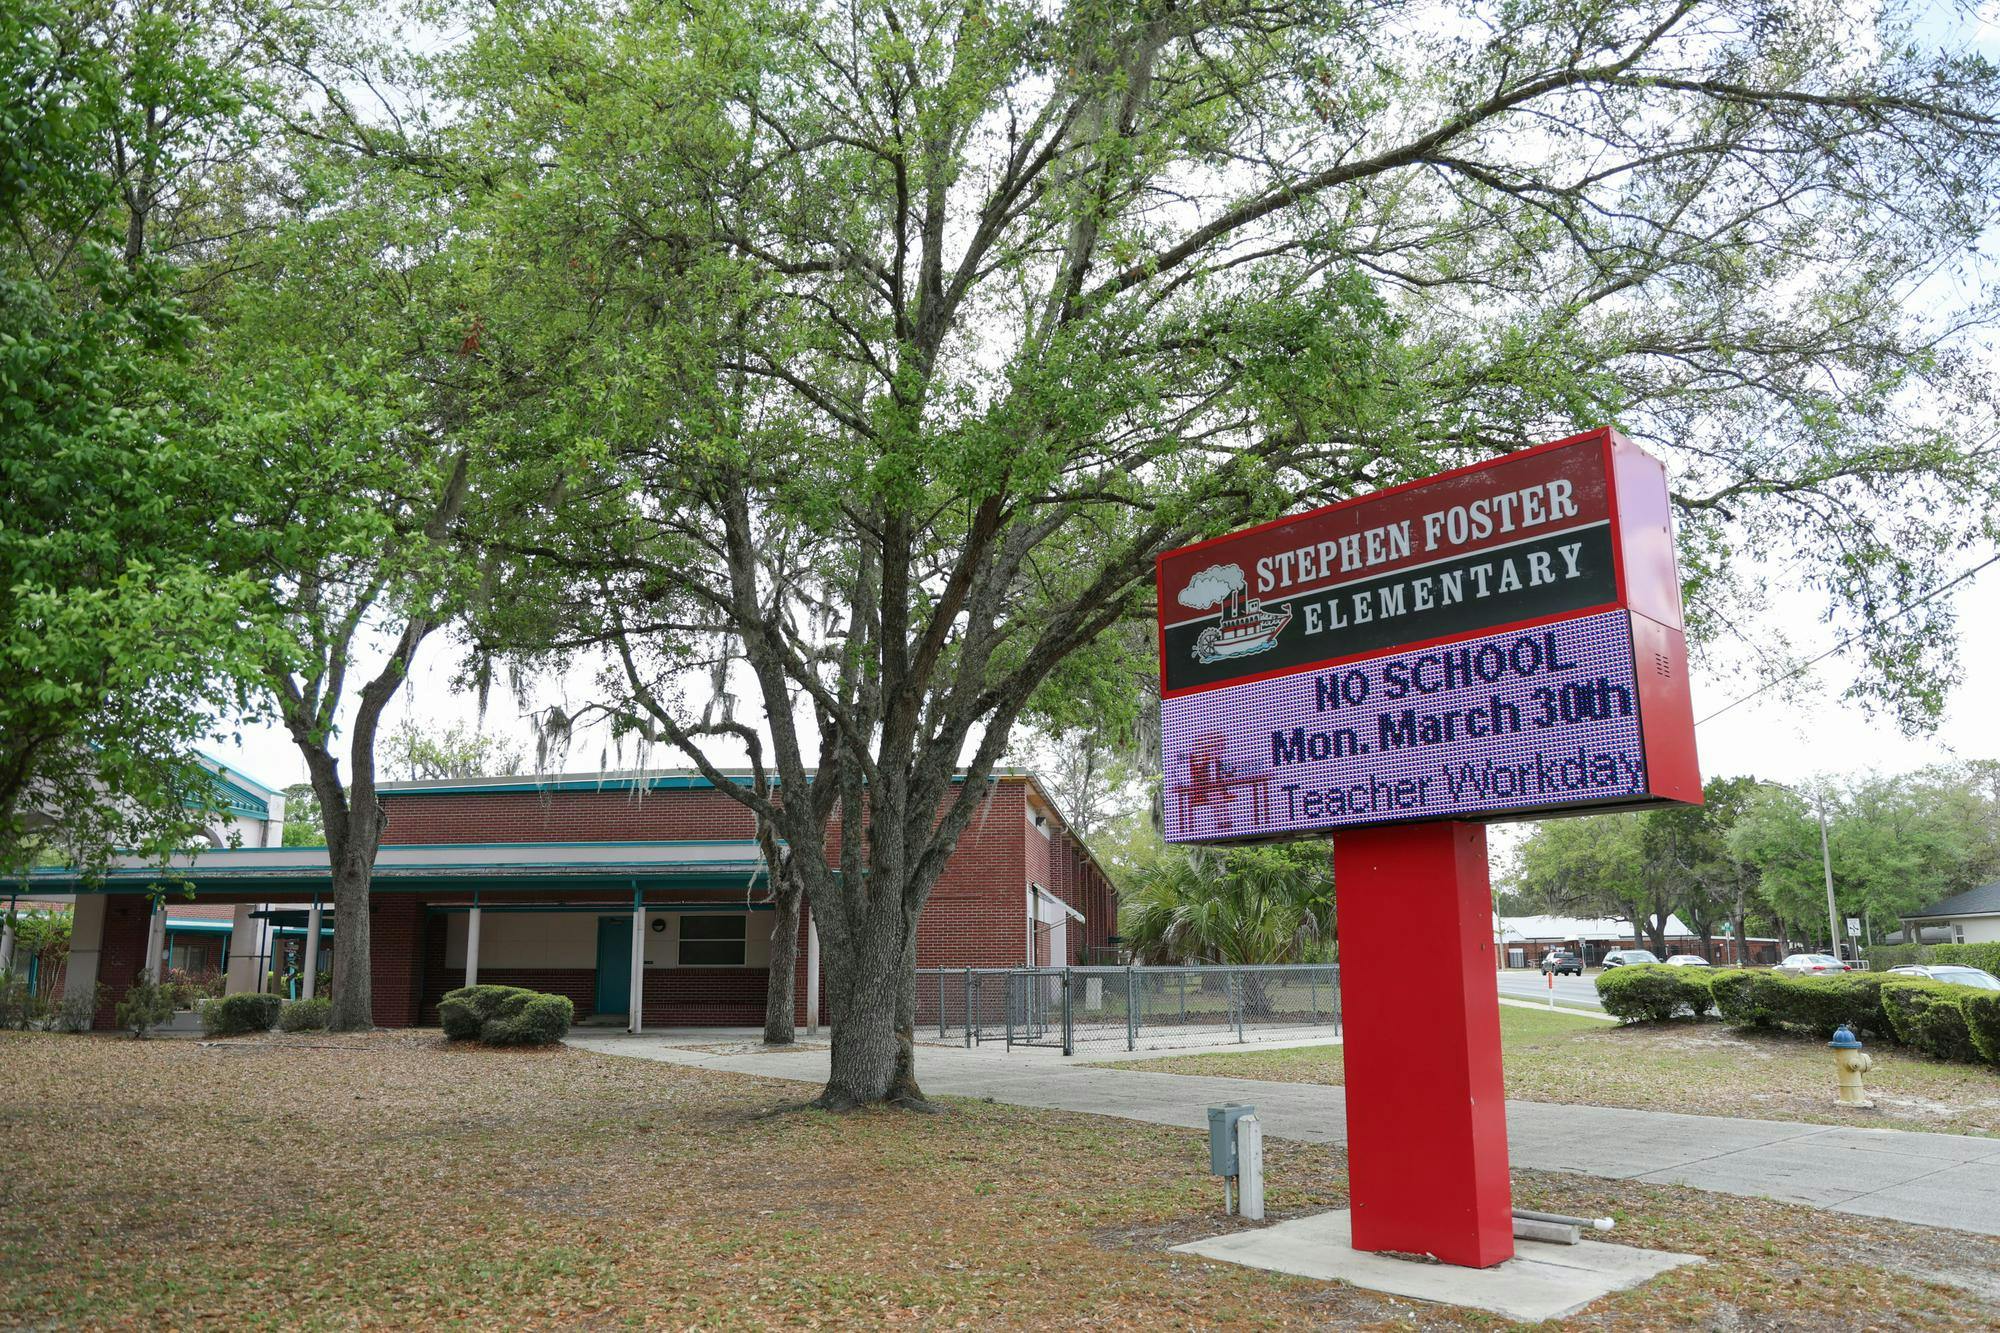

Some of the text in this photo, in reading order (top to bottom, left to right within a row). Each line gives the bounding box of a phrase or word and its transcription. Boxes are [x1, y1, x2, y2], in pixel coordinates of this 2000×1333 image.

[1256, 478, 1579, 593] STEPHEN FOSTER
[1303, 542, 1583, 636] ELEMENTARY
[1315, 632, 1576, 712] NO SCHOOL
[1271, 676, 1632, 768] Mon. March 30th
[1283, 745, 1642, 820] Teacher Workday
